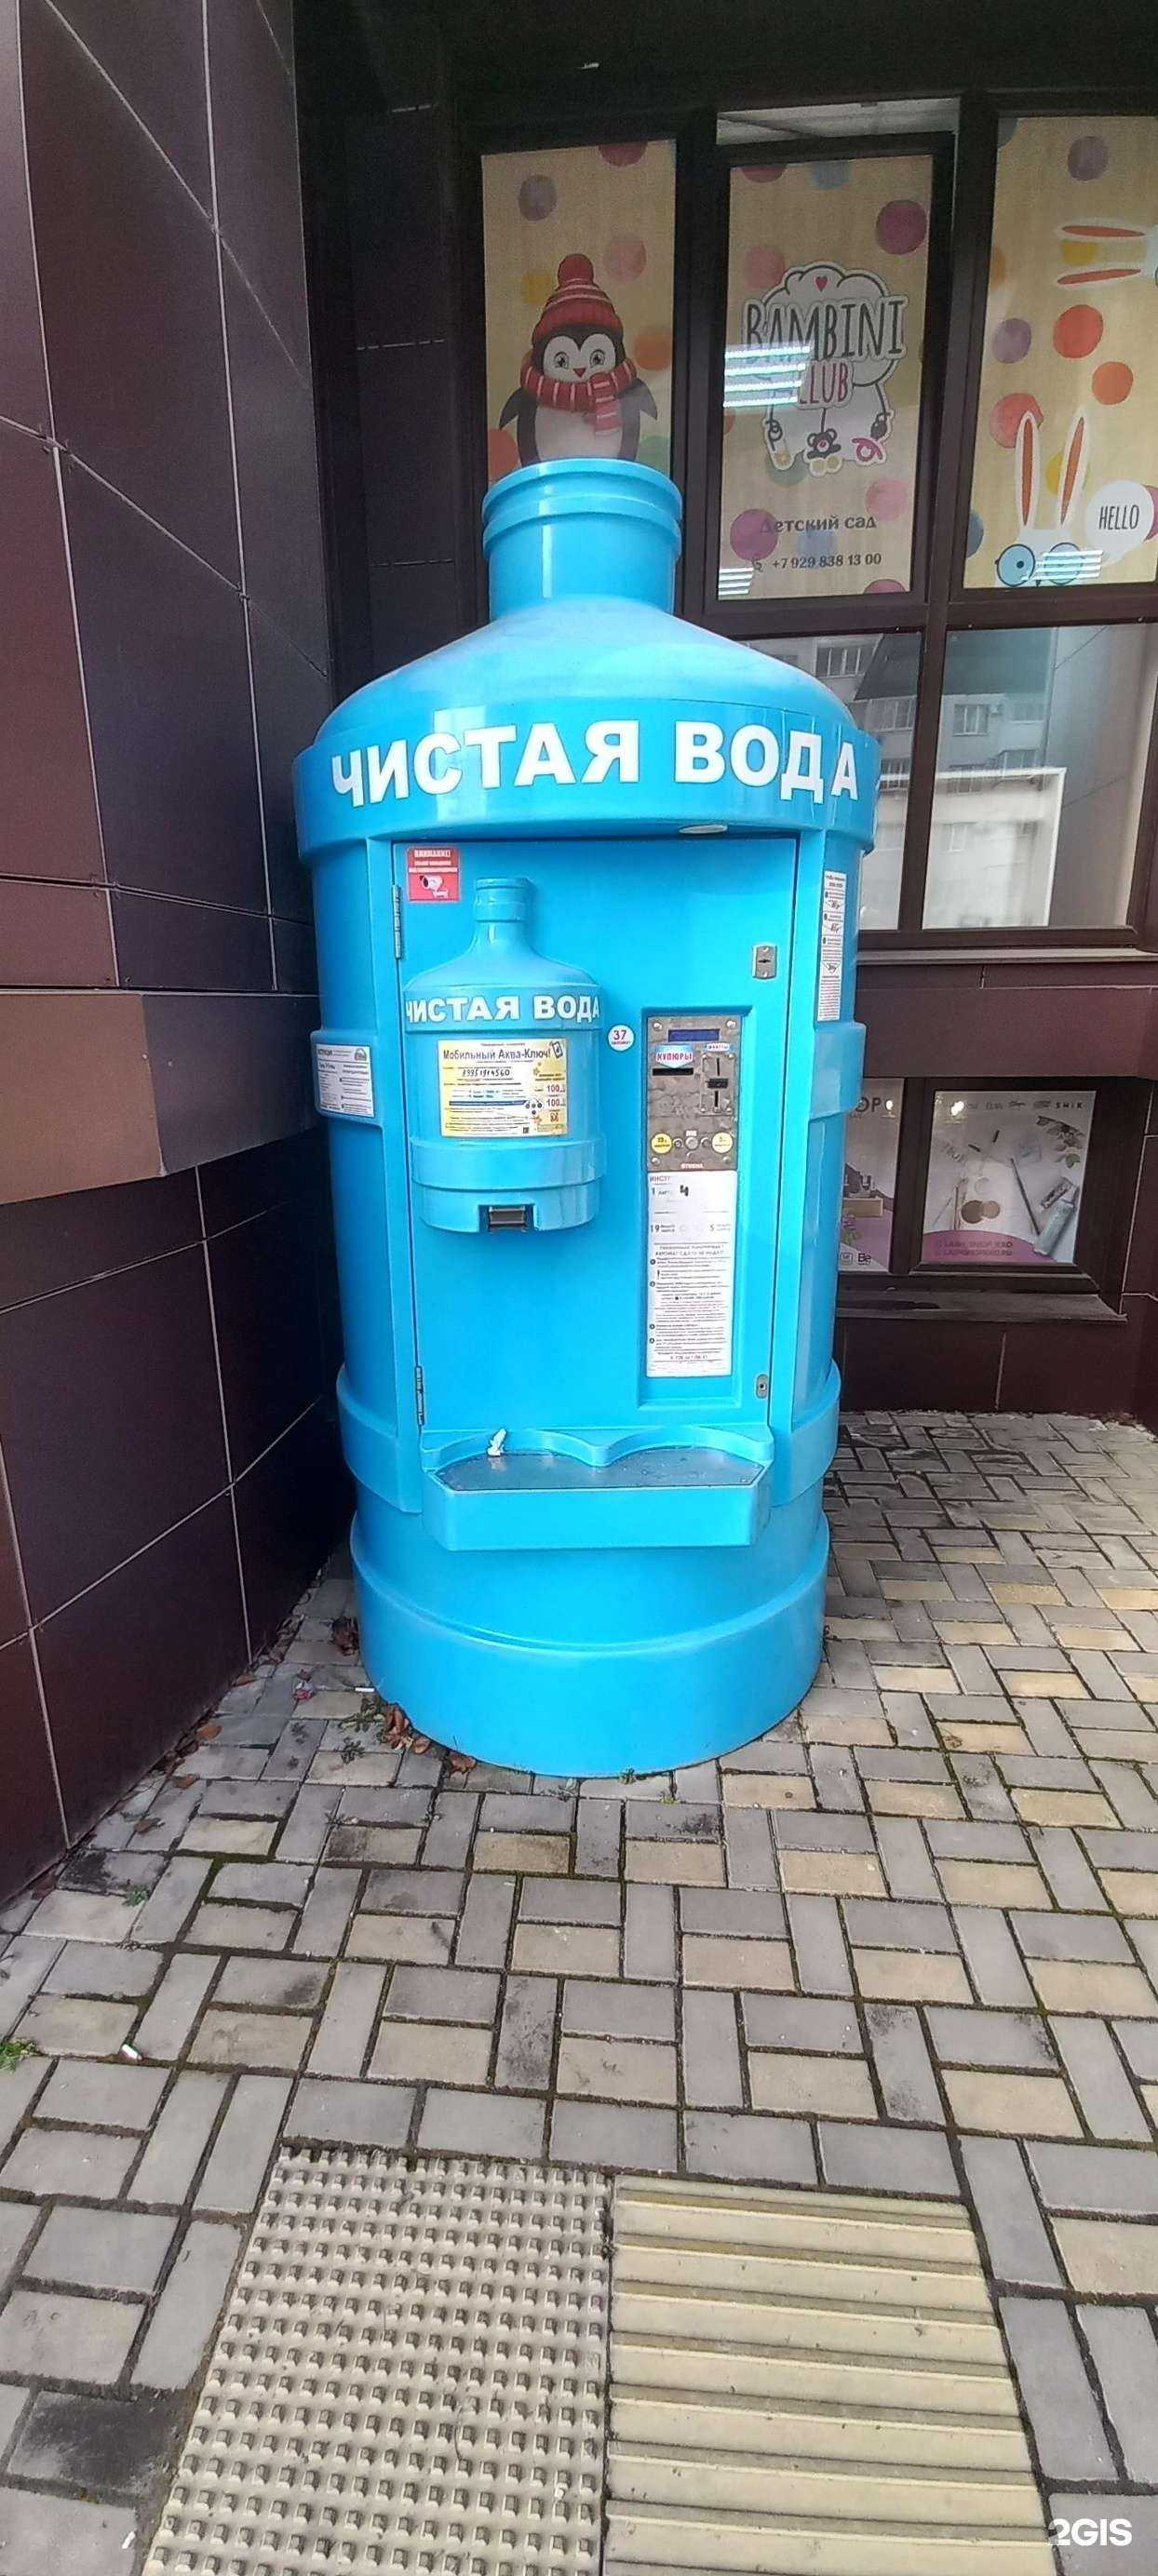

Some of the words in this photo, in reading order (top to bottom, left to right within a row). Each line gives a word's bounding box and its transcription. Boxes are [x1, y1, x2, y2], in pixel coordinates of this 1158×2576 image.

[747, 300, 904, 362] BAMBINI
[799, 362, 849, 405] LUB
[760, 515, 840, 533] Детский
[844, 516, 877, 530] сад
[1098, 503, 1140, 530] HELLO
[772, 558, 787, 570] +7
[791, 557, 815, 570] 929
[819, 555, 843, 568] 838
[848, 554, 861, 567] 13
[865, 553, 882, 566] 00
[331, 720, 640, 808] ЧИСТАЯ
[675, 720, 858, 804] ВОДА
[405, 995, 520, 1024] ЧИСТАЯ
[533, 995, 600, 1024] ВОДА
[613, 1029, 627, 1040] 37
[443, 1049, 496, 1060] Мобильный
[657, 1053, 693, 1061] КУПЮРЫ
